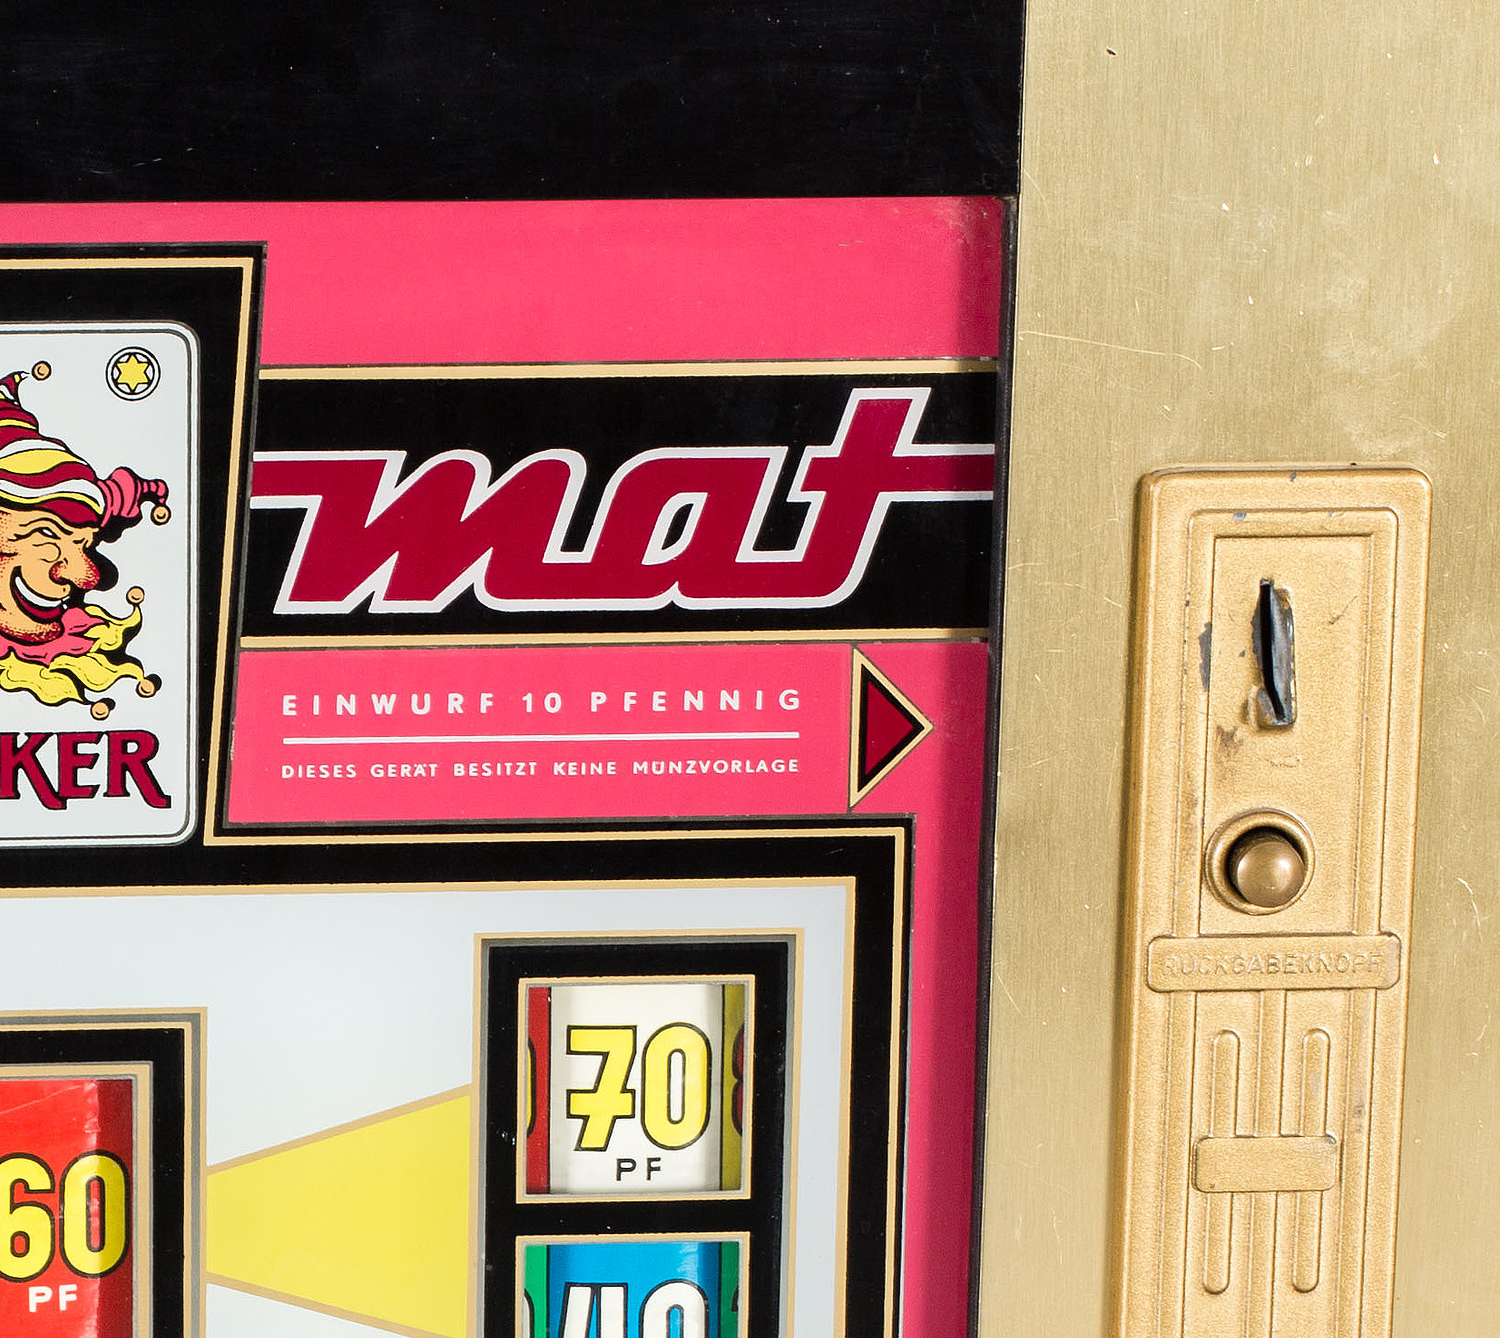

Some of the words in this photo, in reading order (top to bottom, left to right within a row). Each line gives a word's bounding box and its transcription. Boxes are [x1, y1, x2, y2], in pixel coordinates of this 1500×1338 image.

[274, 388, 931, 614] mat
[282, 692, 494, 716] EINWURF
[521, 692, 562, 714] 10
[590, 688, 800, 713] PFENNIG
[281, 763, 357, 779] DIESES
[370, 763, 439, 778] GERÄT
[453, 761, 538, 777] BESITZT
[553, 761, 617, 776] KEINE
[566, 1022, 712, 1152] 70
[615, 1157, 662, 1182] PF
[28, 1283, 78, 1313] PF
